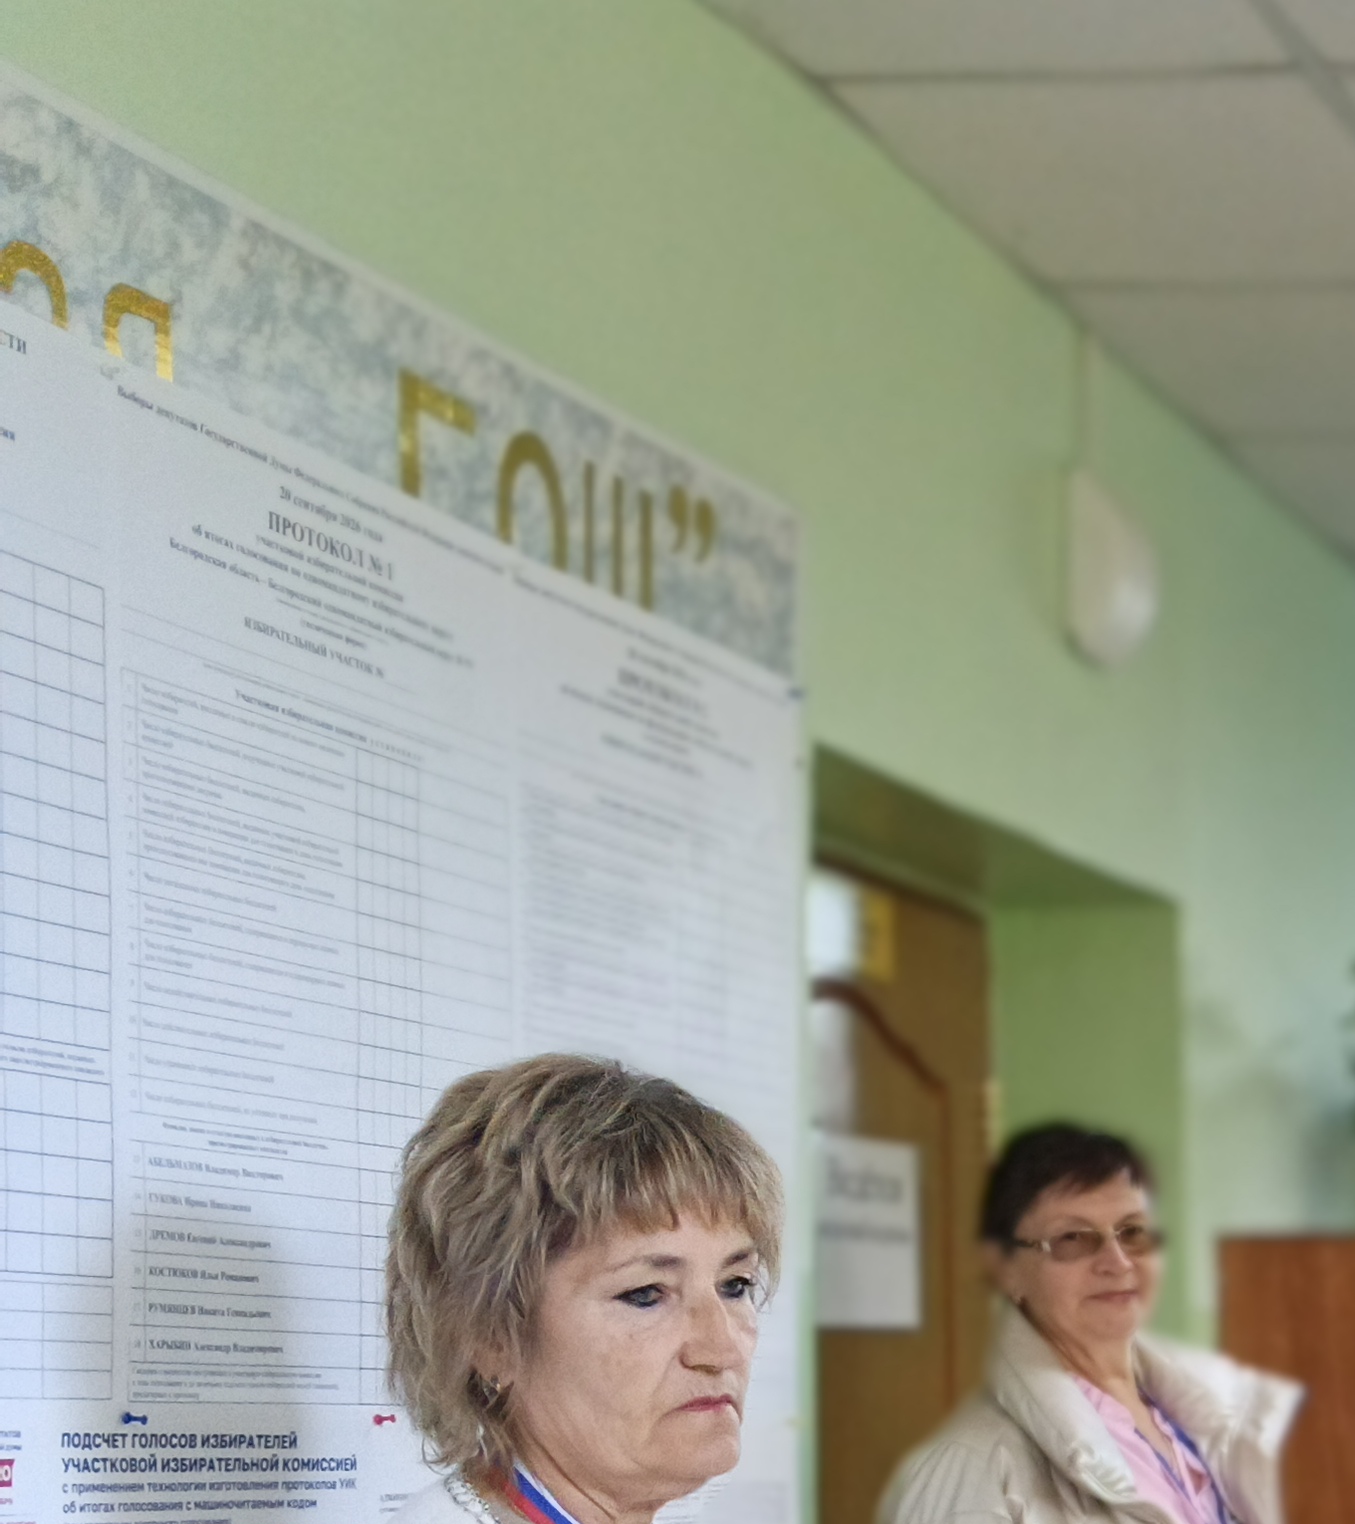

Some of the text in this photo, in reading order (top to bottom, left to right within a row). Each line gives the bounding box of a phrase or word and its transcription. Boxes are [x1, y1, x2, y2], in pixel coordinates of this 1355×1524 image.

[268, 510, 364, 568] ПРОТОКОЛ
[61, 1431, 297, 1450] ПОДСЧЕТ ГОЛОСОВ ИЗБИРАТЕЛЕЙ
[62, 1453, 357, 1473] УЧАСТКОВОЙ ИЗБИРАТЕЛЬНОЙ КОМИССИЕЙ
[62, 1501, 77, 1513] об
[79, 1503, 115, 1513] итогах
[118, 1500, 183, 1512] голосования
[287, 1497, 318, 1510] кодом
